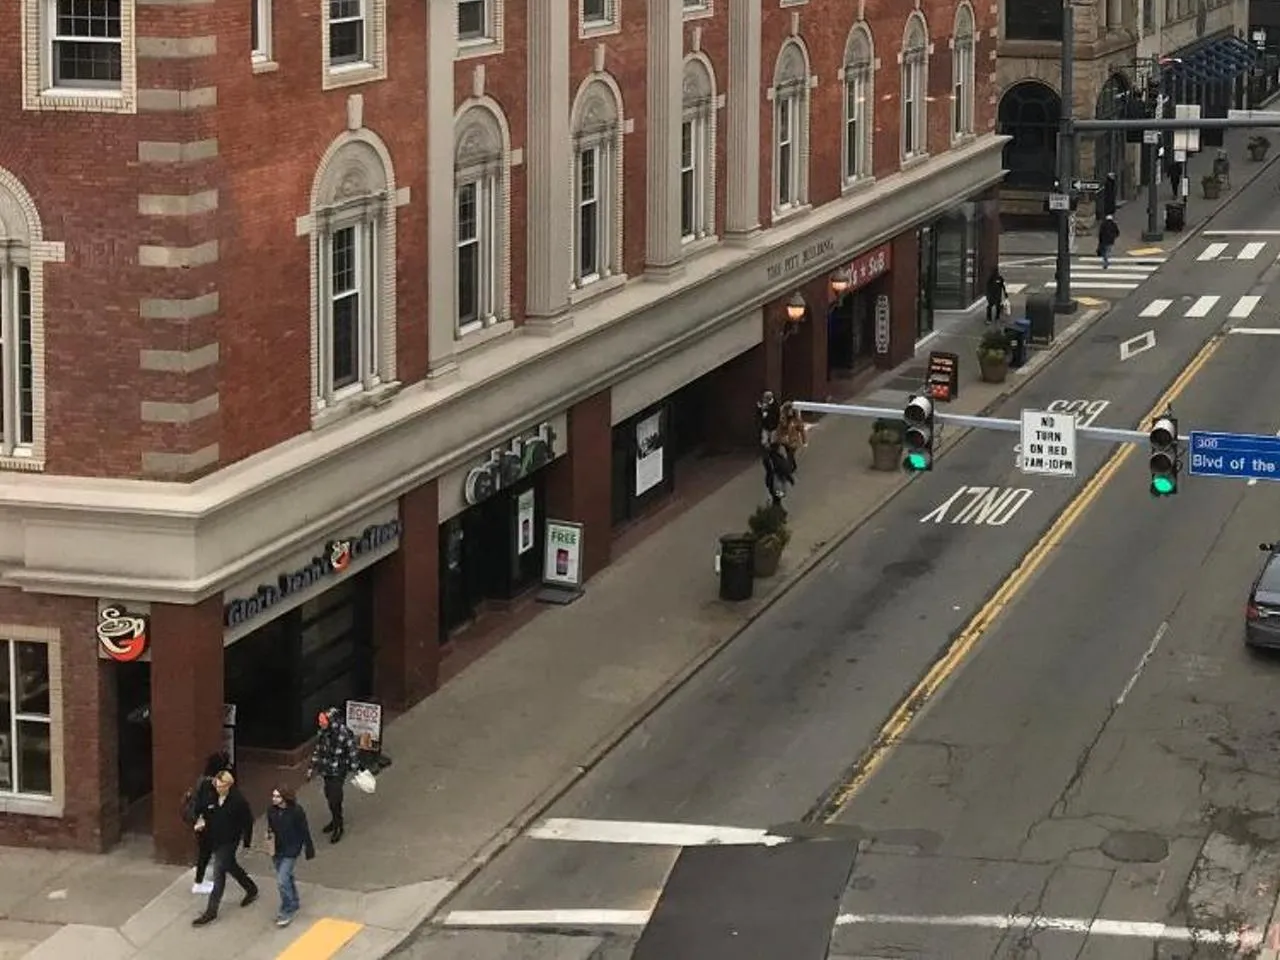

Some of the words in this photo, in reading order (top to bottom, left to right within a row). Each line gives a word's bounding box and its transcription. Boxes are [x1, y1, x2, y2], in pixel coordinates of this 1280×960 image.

[1041, 417, 1055, 427] NO
[1035, 430, 1062, 442] TURN
[1030, 443, 1044, 454] ON
[1047, 445, 1067, 456] RED
[1192, 454, 1223, 468] Blvd
[1230, 457, 1245, 470] of
[1252, 459, 1275, 472] the
[551, 531, 577, 545] FREE
